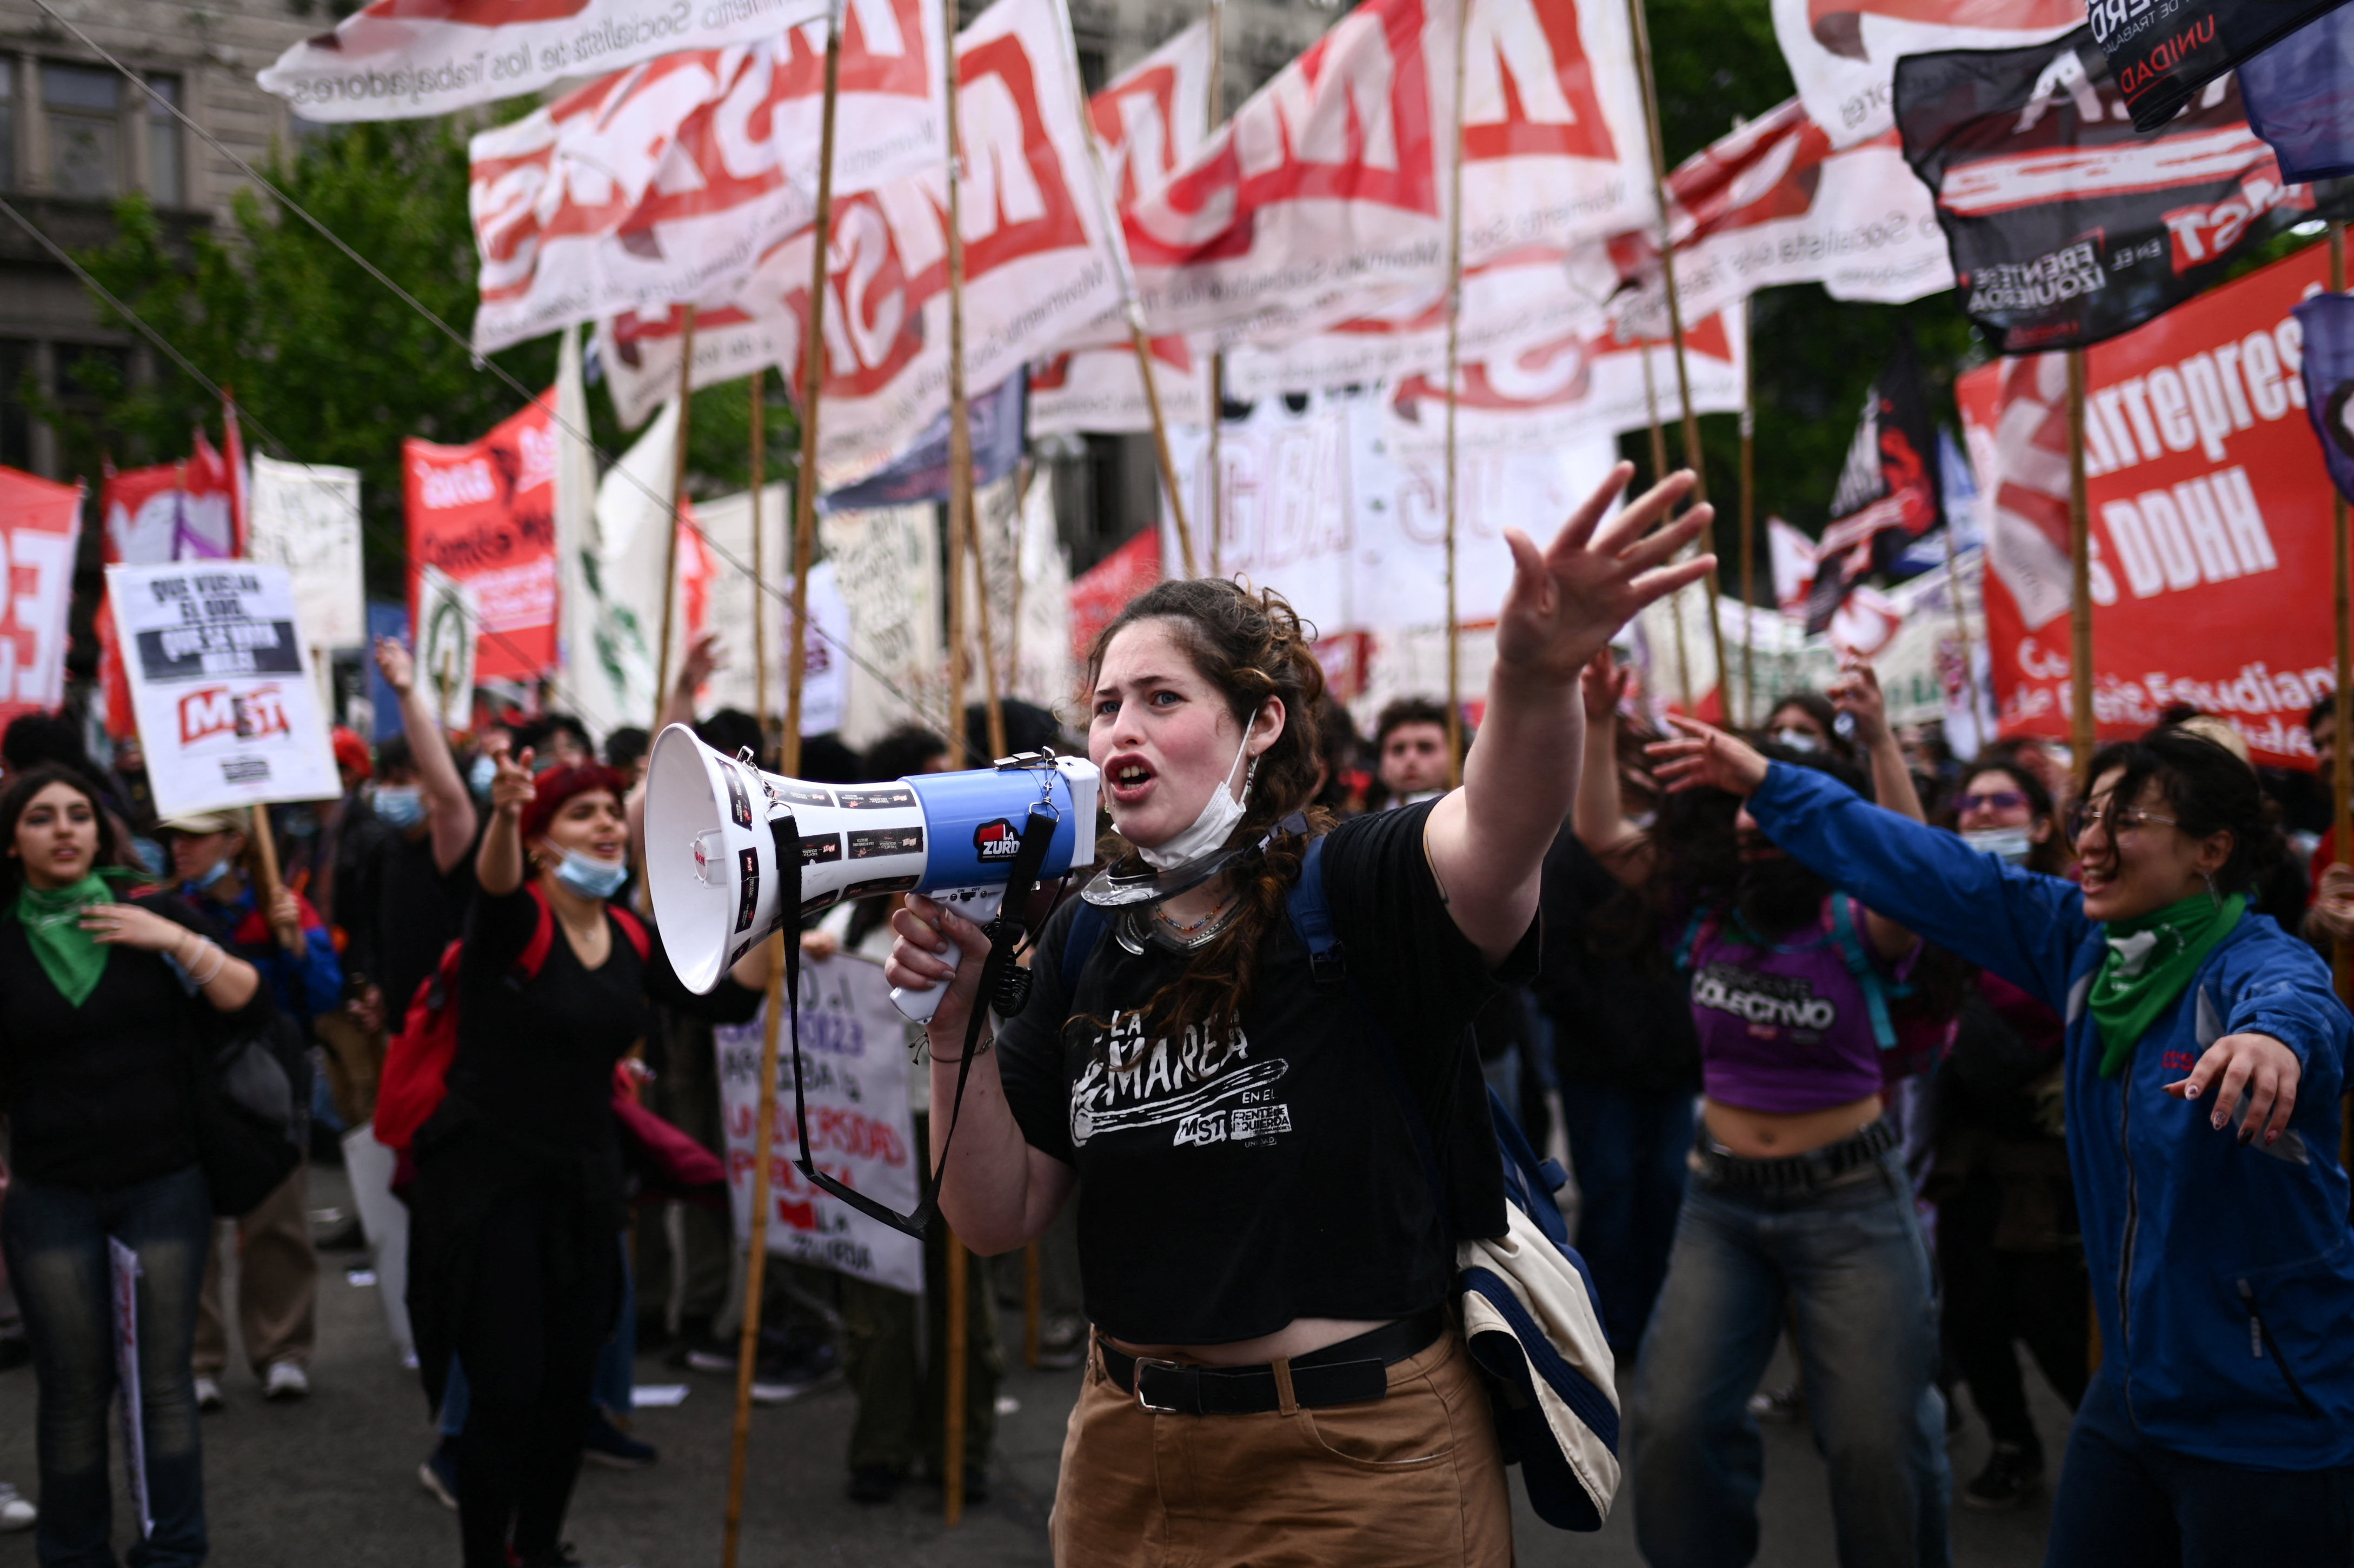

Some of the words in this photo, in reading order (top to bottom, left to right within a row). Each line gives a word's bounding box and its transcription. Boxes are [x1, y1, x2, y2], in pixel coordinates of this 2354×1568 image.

[2101, 464, 2279, 599] DDHH
[1003, 823, 1014, 841] LA
[822, 843, 836, 853] MST
[983, 840, 1021, 855] ZURD
[1111, 1010, 1141, 1038] LA
[1101, 1009, 1249, 1106] MAREA
[1242, 1092, 1260, 1104] EN
[1263, 1089, 1275, 1101] EL
[1233, 1108, 1273, 1121] FRENTE
[1176, 1111, 1226, 1145] MST
[1233, 1117, 1290, 1132] IQUIERDA
